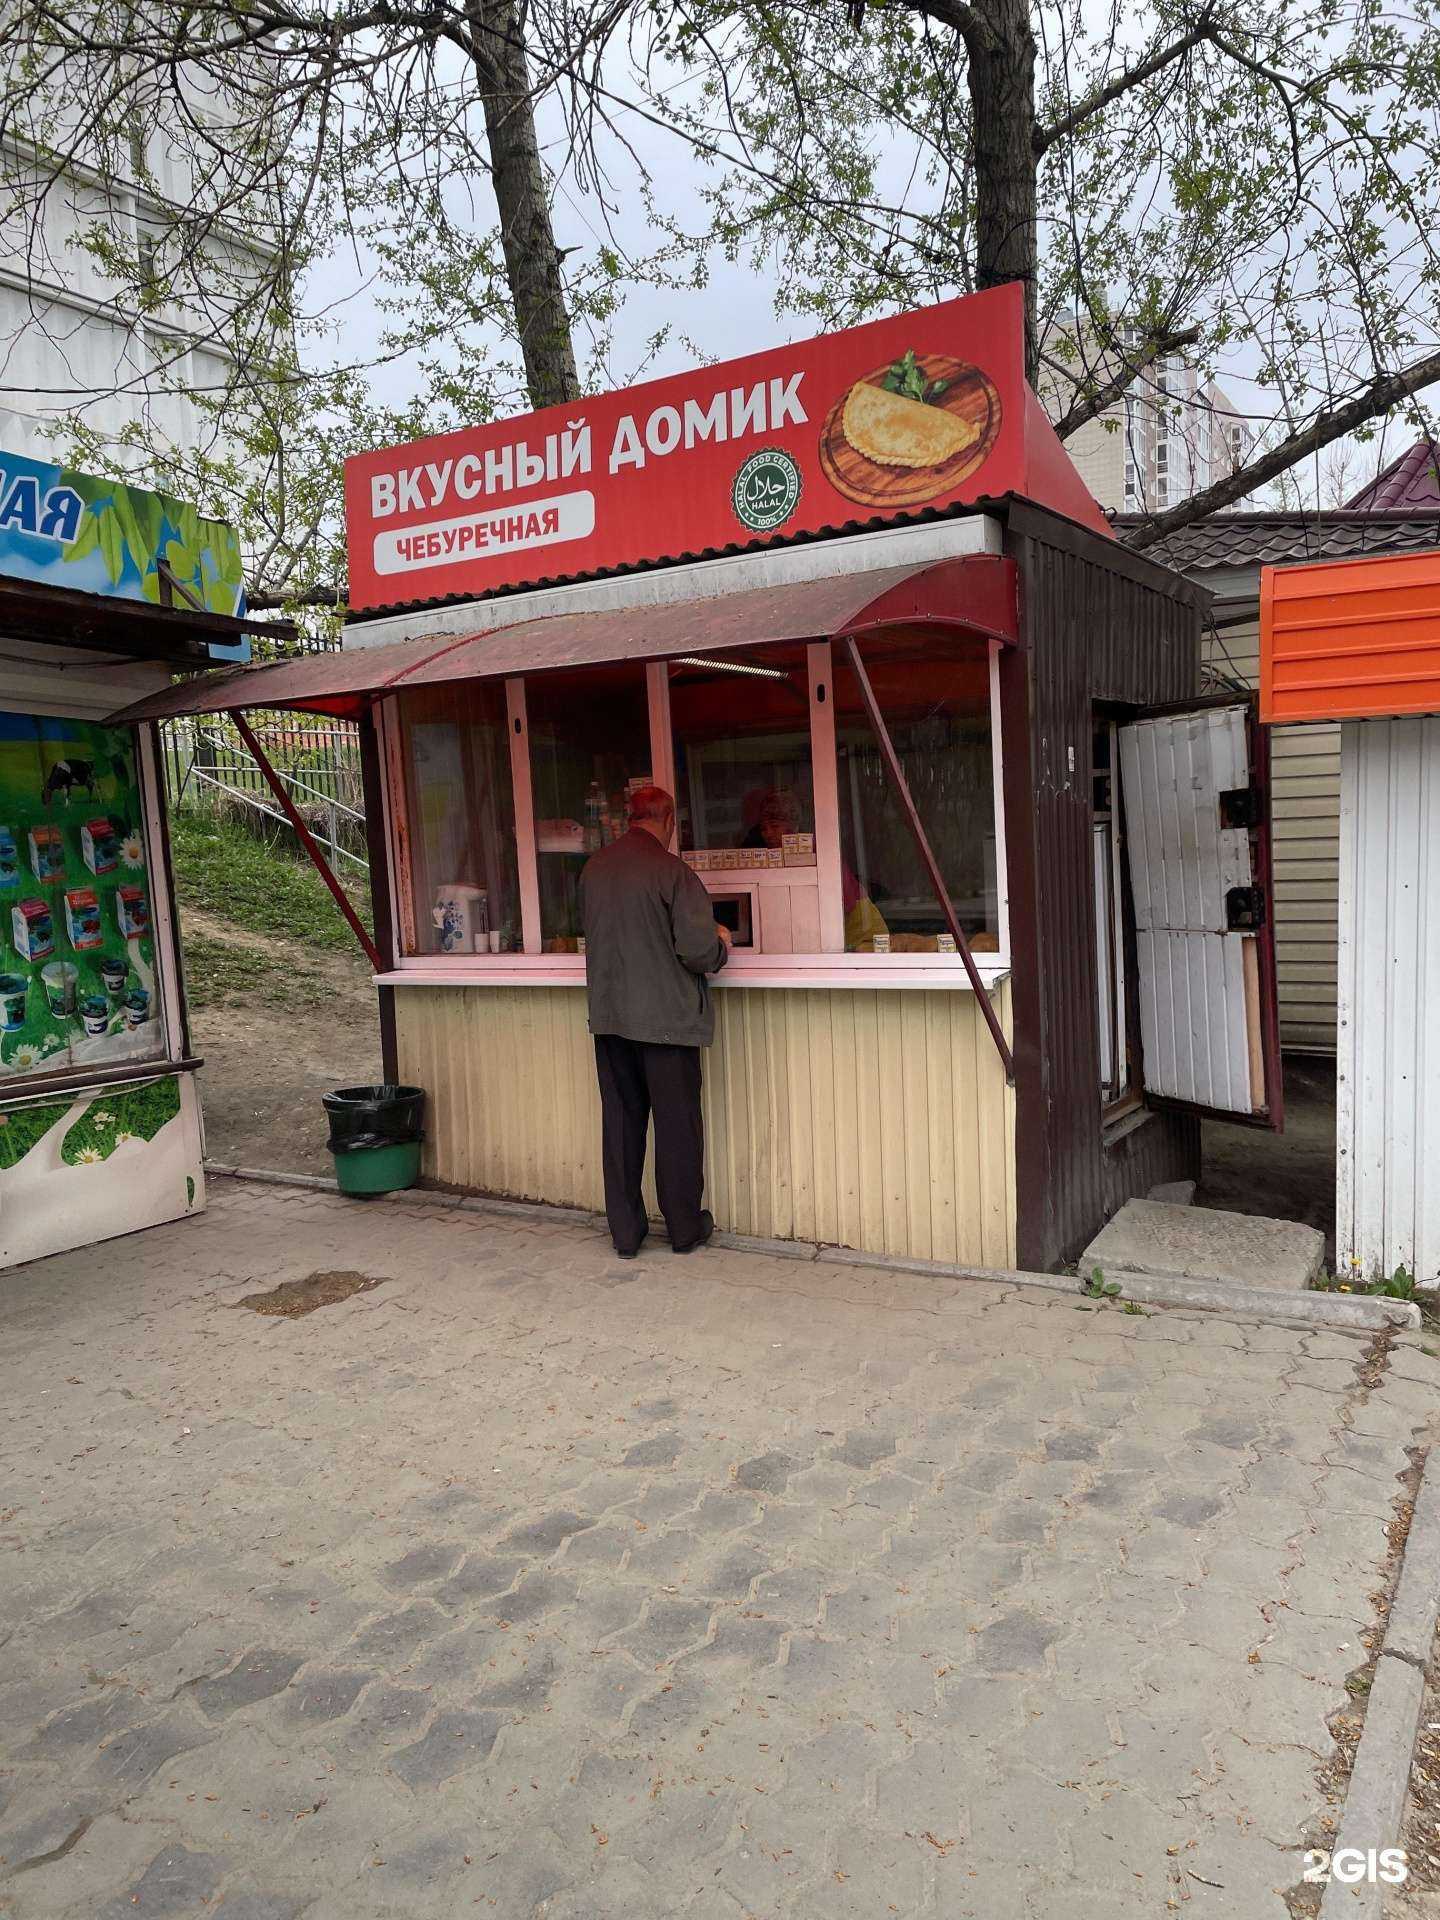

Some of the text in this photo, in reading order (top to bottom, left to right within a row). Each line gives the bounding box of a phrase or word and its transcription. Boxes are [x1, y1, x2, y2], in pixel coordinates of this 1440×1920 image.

[371, 371, 809, 519] ВКУСНЫЙ ДОМИК
[0, 469, 85, 544] АЯ
[737, 455, 796, 509] HALAL FOOD CERTIFIED
[746, 475, 785, 501] حلال
[751, 497, 781, 510] HALAL
[396, 508, 559, 561] ЧЕБУРЕЧНАЯ
[757, 515, 778, 526] 100%
